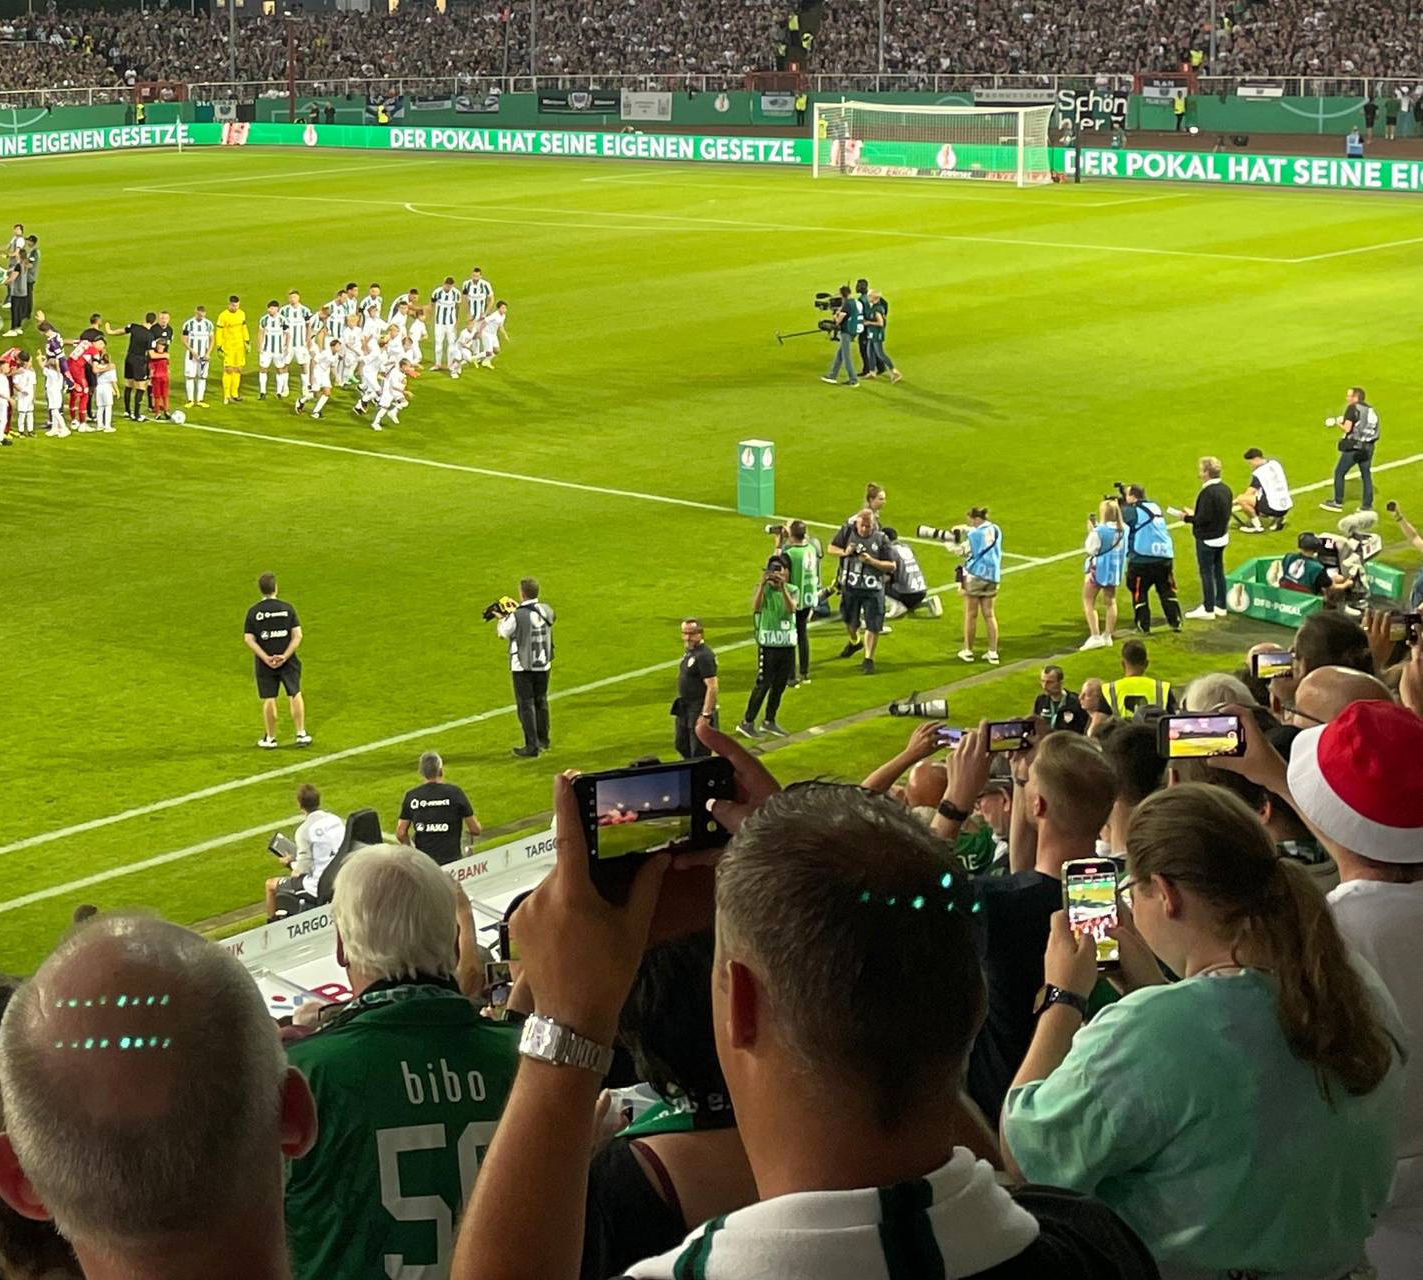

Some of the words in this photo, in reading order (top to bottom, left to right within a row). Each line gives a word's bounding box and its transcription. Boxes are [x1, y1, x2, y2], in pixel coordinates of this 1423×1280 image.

[1058, 89, 1128, 113] Schön
[33, 130, 105, 154] EIGENEN
[109, 124, 195, 148] GESETZE.
[390, 128, 427, 149] DER
[432, 129, 494, 151] POKAL
[498, 131, 536, 152] HAT
[540, 132, 597, 155] SEINE
[602, 134, 694, 159] EIGENEN
[699, 138, 802, 163] GESETZE.
[1064, 149, 1118, 176] DER
[1126, 152, 1222, 180] POKAL
[1228, 156, 1287, 183] HAT
[1293, 159, 1382, 188] SEINE
[425, 822, 450, 833] JAKO
[457, 861, 489, 881] BANK
[286, 914, 329, 940] TARGO
[400, 1057, 487, 1105] bibo
